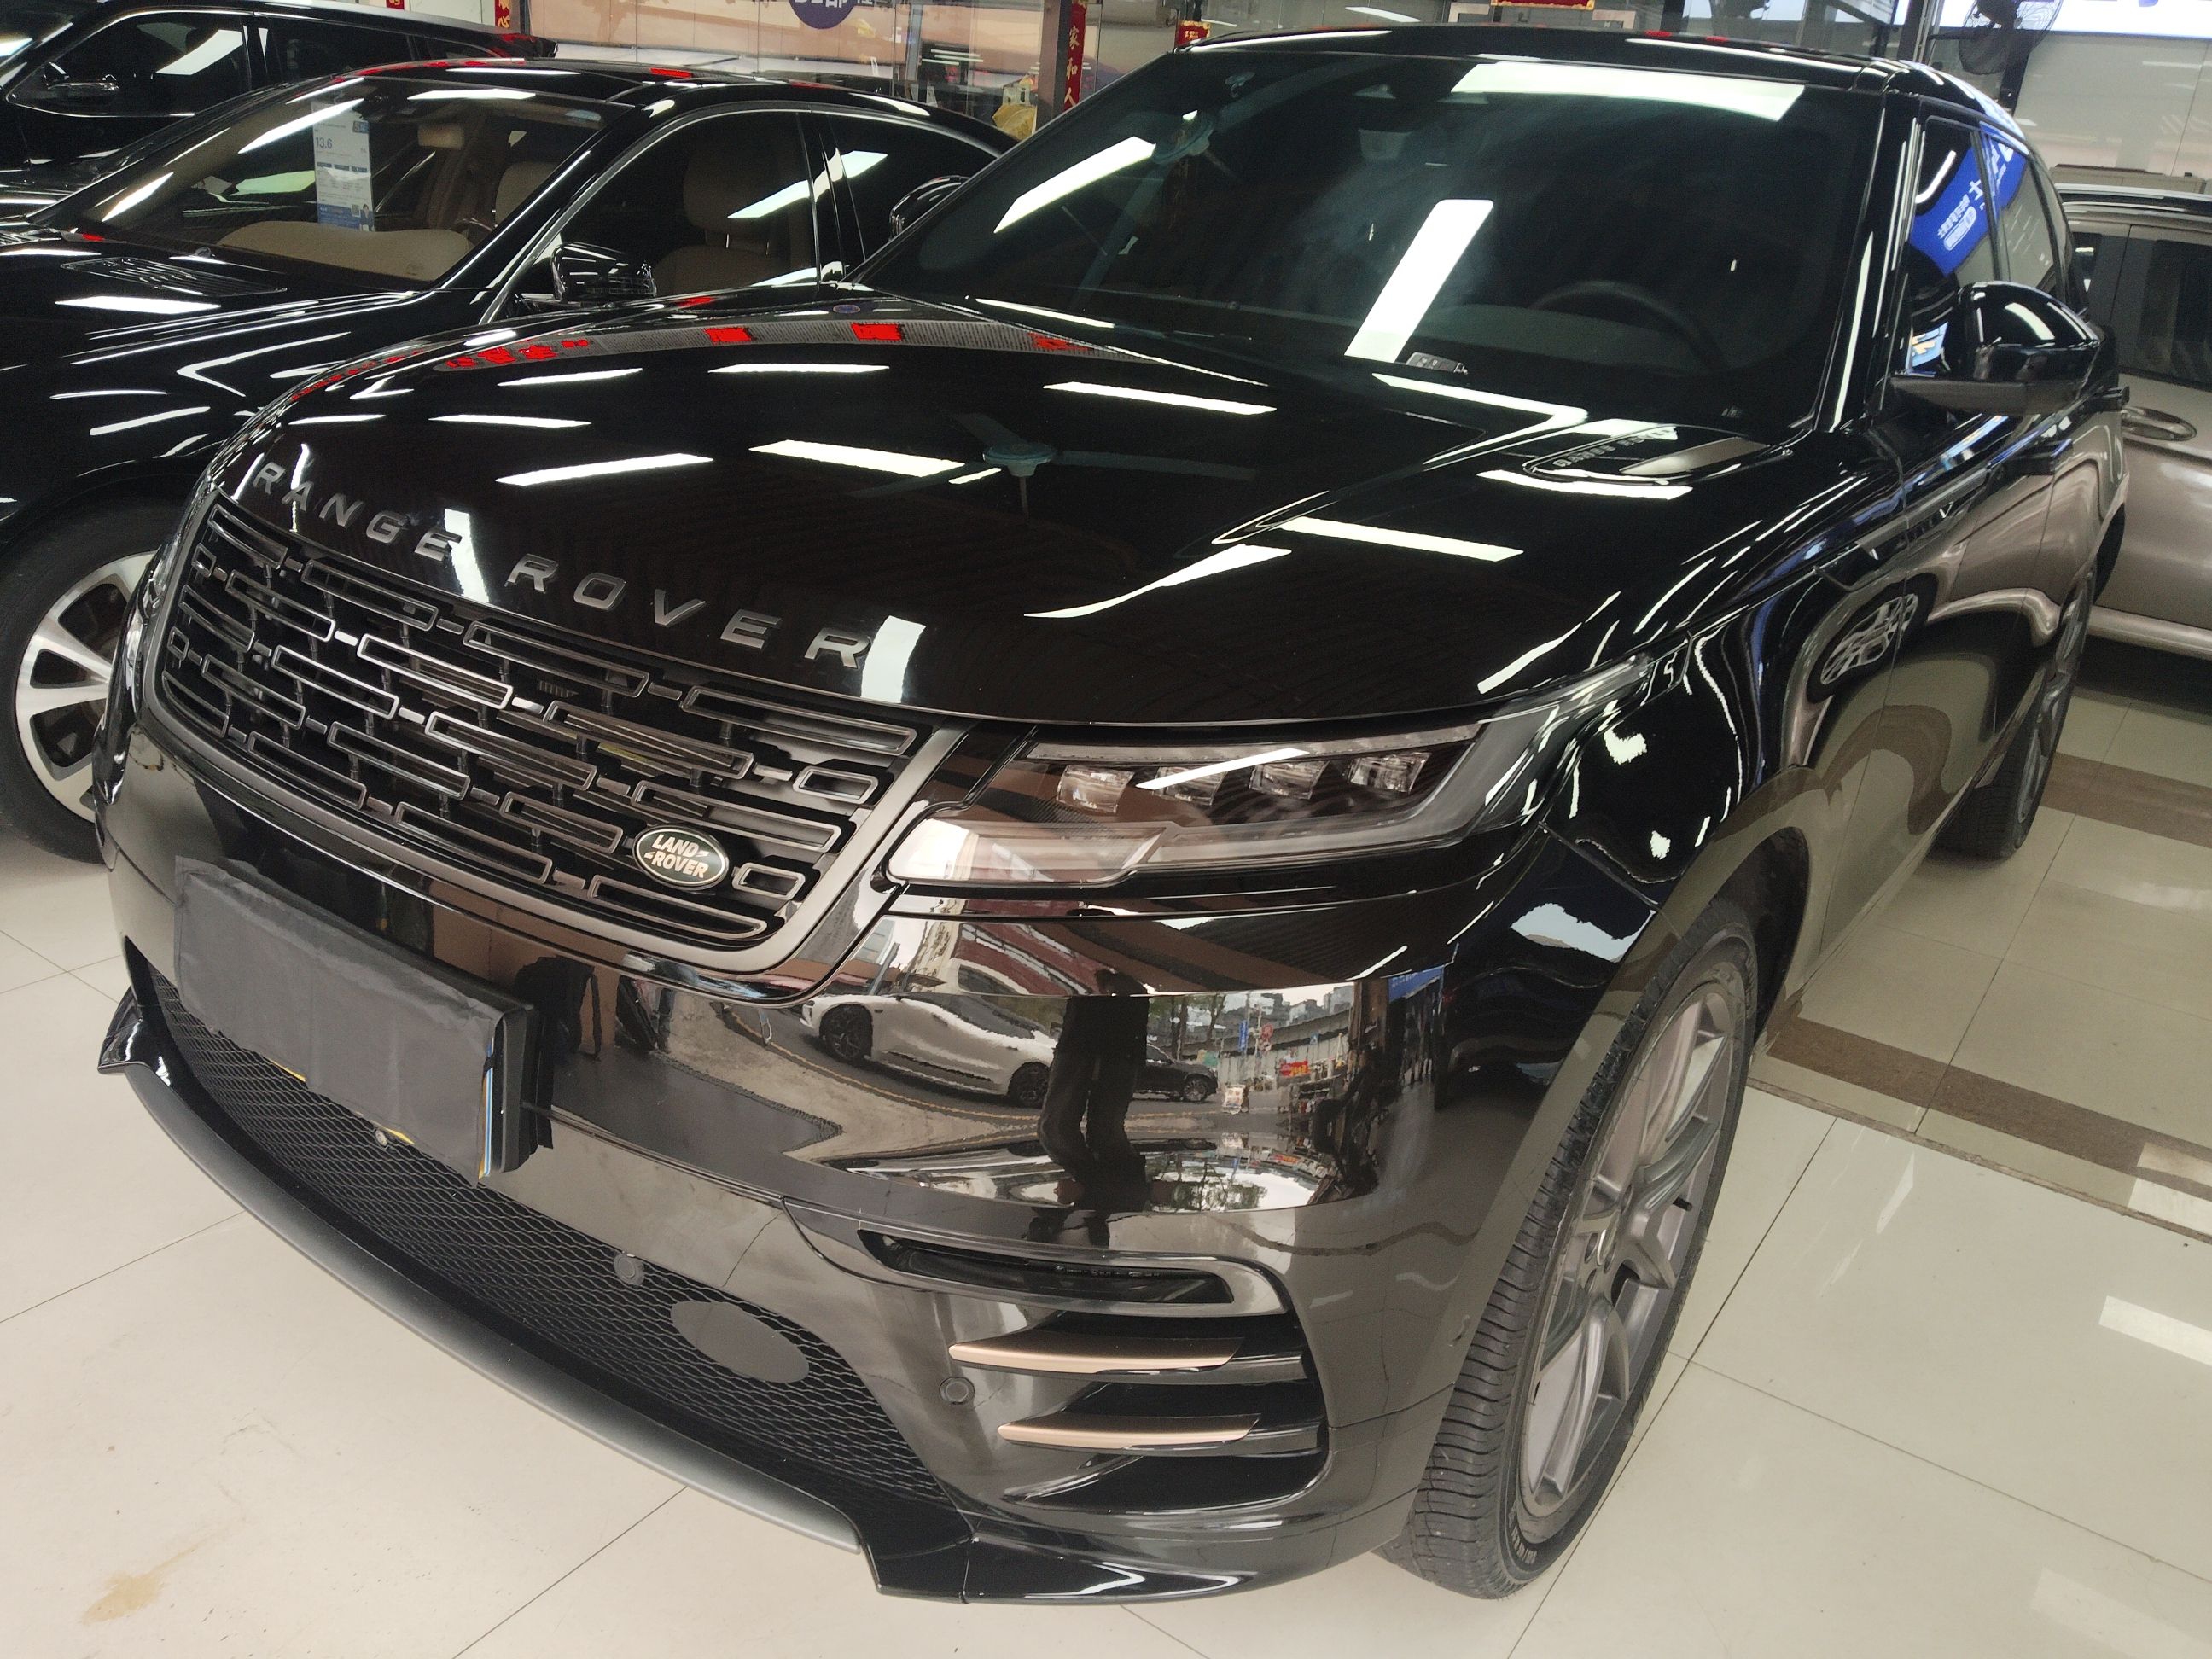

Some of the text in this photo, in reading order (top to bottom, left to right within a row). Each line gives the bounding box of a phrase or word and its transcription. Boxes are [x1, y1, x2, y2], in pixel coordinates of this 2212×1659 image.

[1064, 25, 1080, 107] 家和人
[316, 137, 333, 149] 13.6
[253, 461, 871, 669] RANGE ROVER
[652, 834, 700, 858] LAND
[651, 851, 709, 878] ROVER
